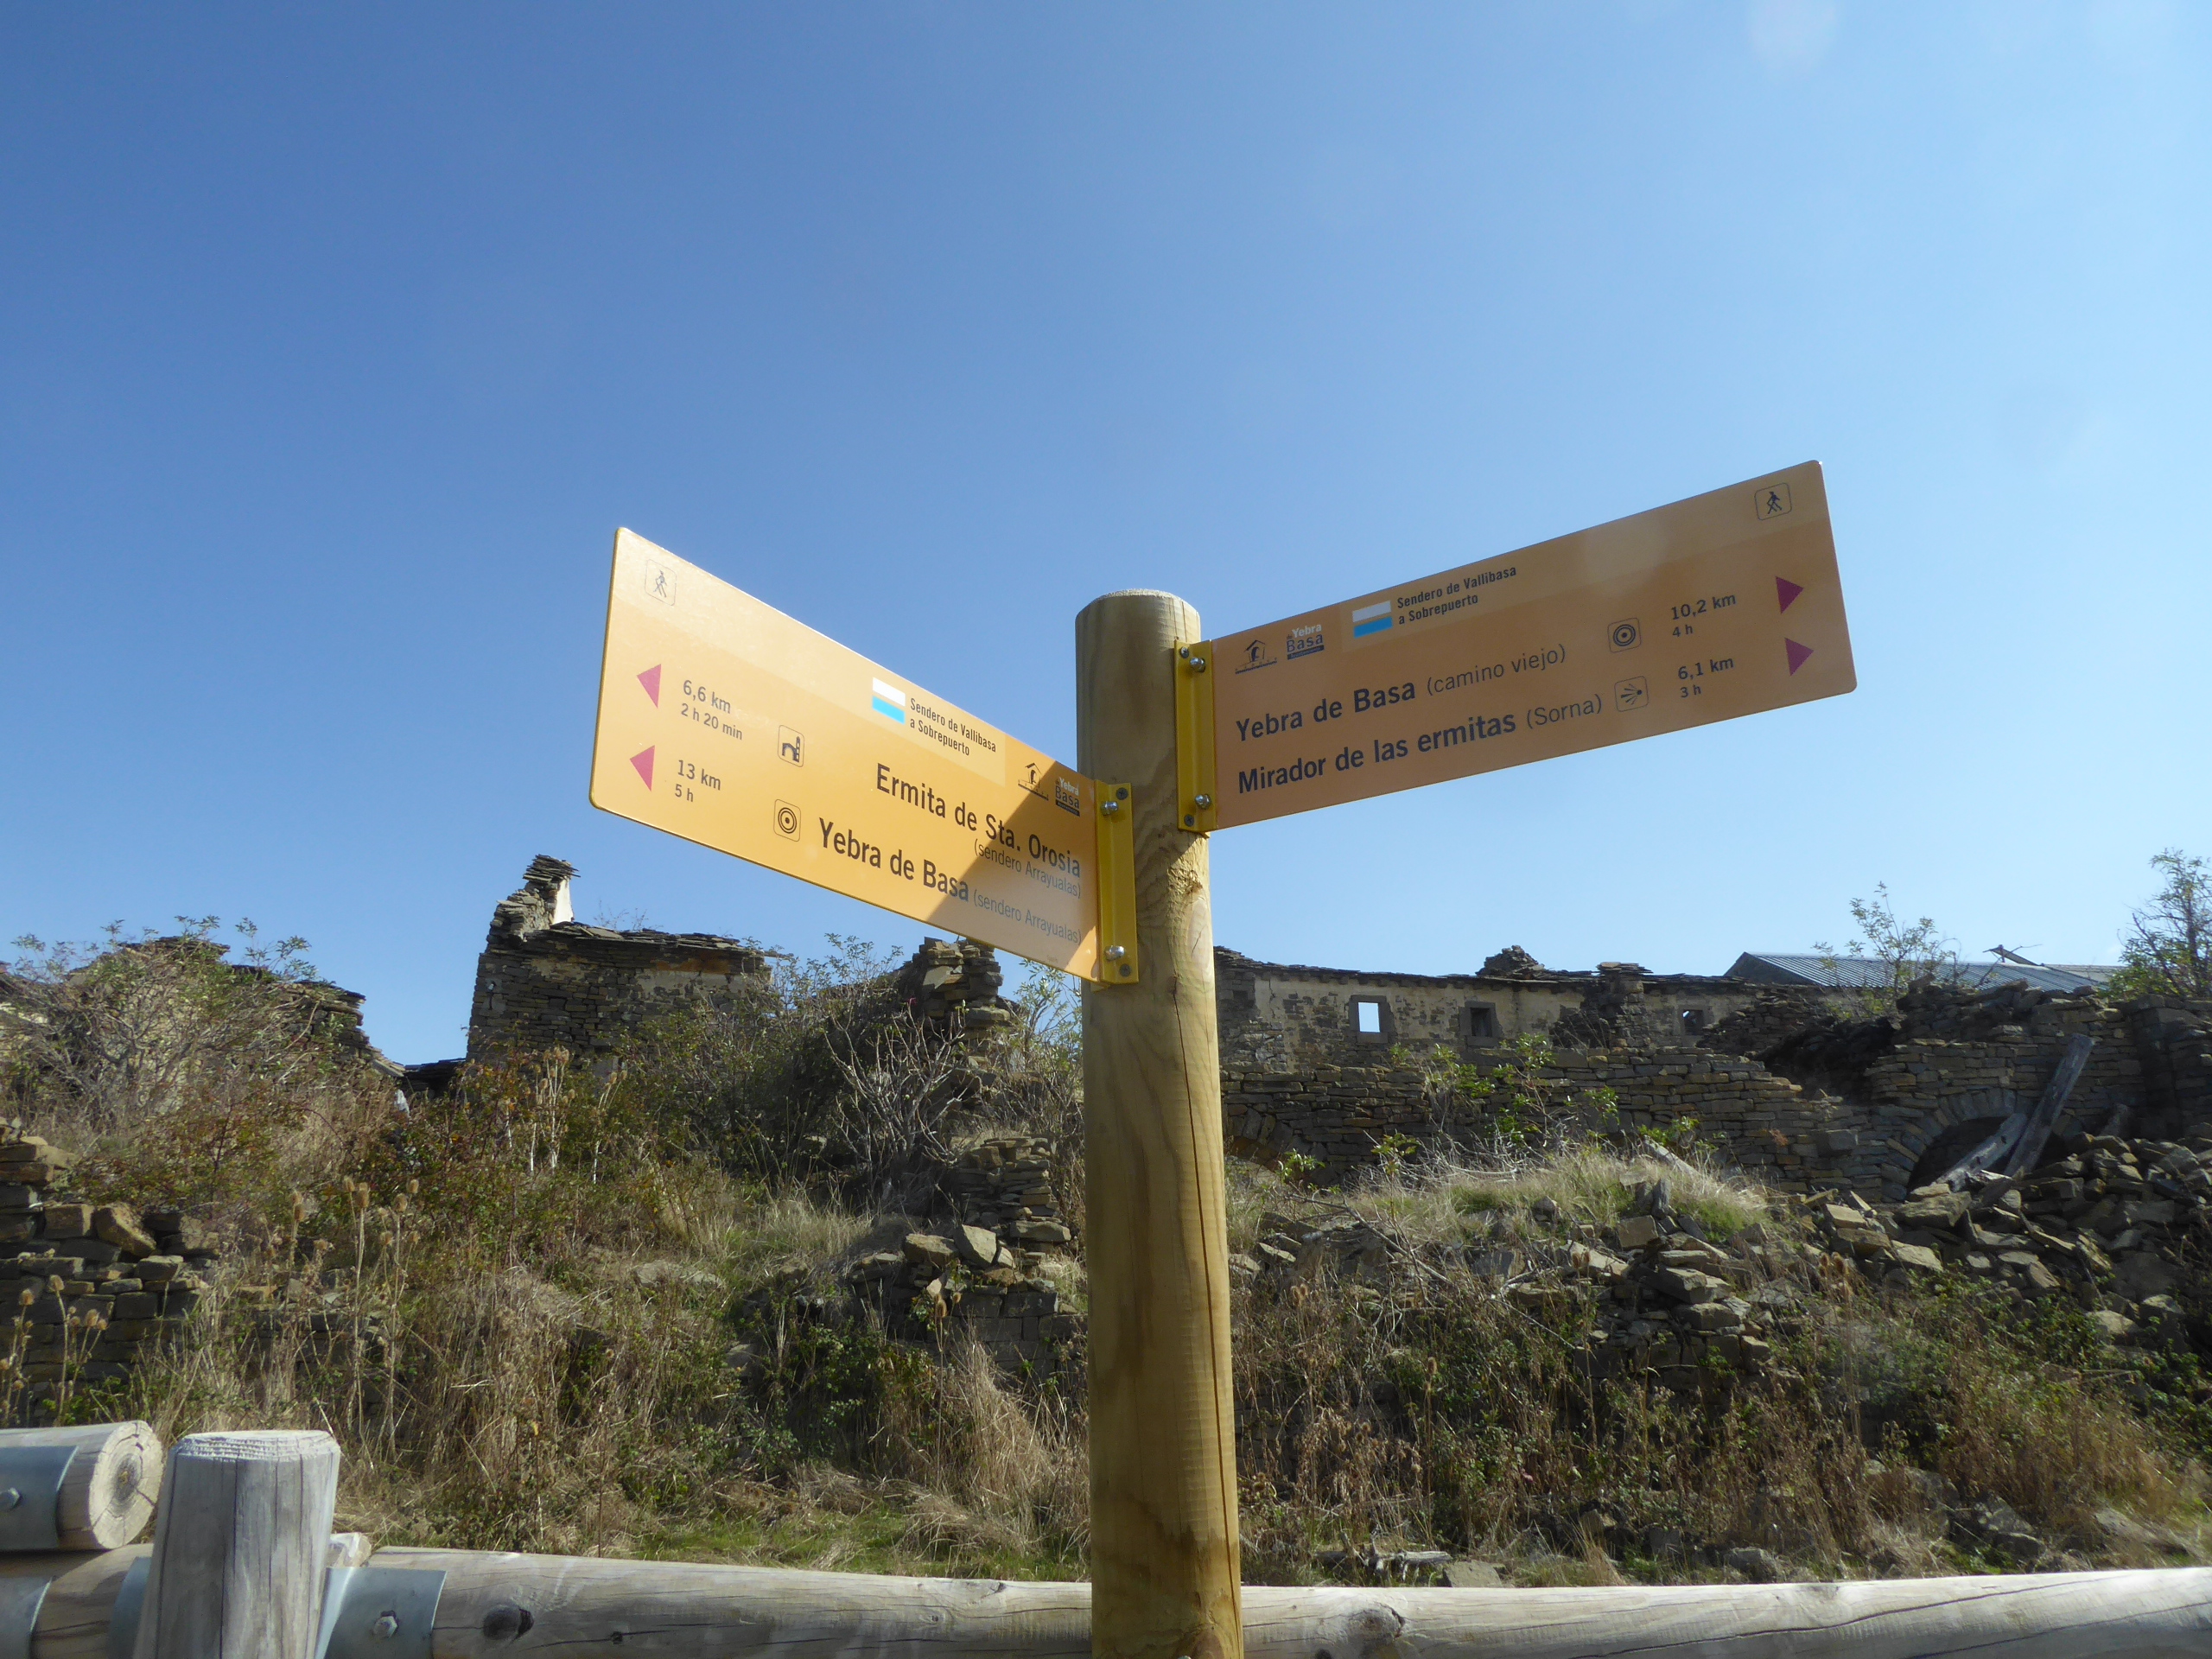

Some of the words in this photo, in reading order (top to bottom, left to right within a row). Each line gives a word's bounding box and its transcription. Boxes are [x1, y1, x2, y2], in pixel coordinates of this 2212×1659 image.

[1397, 588, 1443, 608] Sendero
[1446, 582, 1460, 595] de
[1464, 567, 1516, 589] Vallibasa
[1398, 614, 1405, 625] a
[1408, 594, 1478, 622] Sobrepuerto
[1671, 599, 1707, 620] 10,2
[1712, 594, 1736, 609] km
[1287, 634, 1323, 652] Basa
[1291, 624, 1322, 638] Yebra
[1672, 626, 1681, 637] 4
[1685, 624, 1693, 634] h
[1678, 662, 1704, 680] 6,1
[1710, 658, 1734, 672] km
[683, 679, 707, 702] 6,6
[711, 691, 731, 714] km
[1236, 711, 1303, 741] Yebra
[1313, 698, 1342, 722] de
[1353, 682, 1415, 713] Basa
[1427, 664, 1504, 696] (camino
[1511, 644, 1566, 673] viejo)
[1680, 686, 1688, 698] 3
[1693, 684, 1701, 696] h
[681, 702, 689, 717] 2
[693, 708, 700, 721] h
[703, 713, 719, 729] 20
[722, 724, 743, 741] min
[910, 697, 945, 726] Sendero
[948, 718, 958, 733] de
[960, 723, 996, 753] Vallibasa
[910, 718, 915, 729] a
[918, 720, 970, 756] Sobrepuerto
[1238, 758, 1326, 794] Mirador
[1335, 747, 1363, 772] de
[1374, 739, 1408, 763] las
[1417, 714, 1516, 753] ermitas
[1527, 693, 1602, 729] (Sorna)
[677, 760, 696, 780] 13
[701, 768, 721, 791] km
[1059, 777, 1079, 796] Yebra
[675, 783, 683, 798] 5
[687, 787, 694, 802] h
[1055, 785, 1079, 809] Basa
[877, 763, 945, 818] Ermita
[955, 802, 977, 831] de
[985, 813, 1020, 852] Sta.
[1028, 834, 1080, 878] Orosia
[819, 817, 881, 868] Yebra
[890, 849, 914, 880] de
[923, 859, 969, 902] Basa
[974, 889, 1021, 921] (sendero
[1025, 910, 1082, 946] Arrayualas)
[974, 838, 1021, 873] (sendero
[1025, 861, 1081, 899] Arrayualas)
